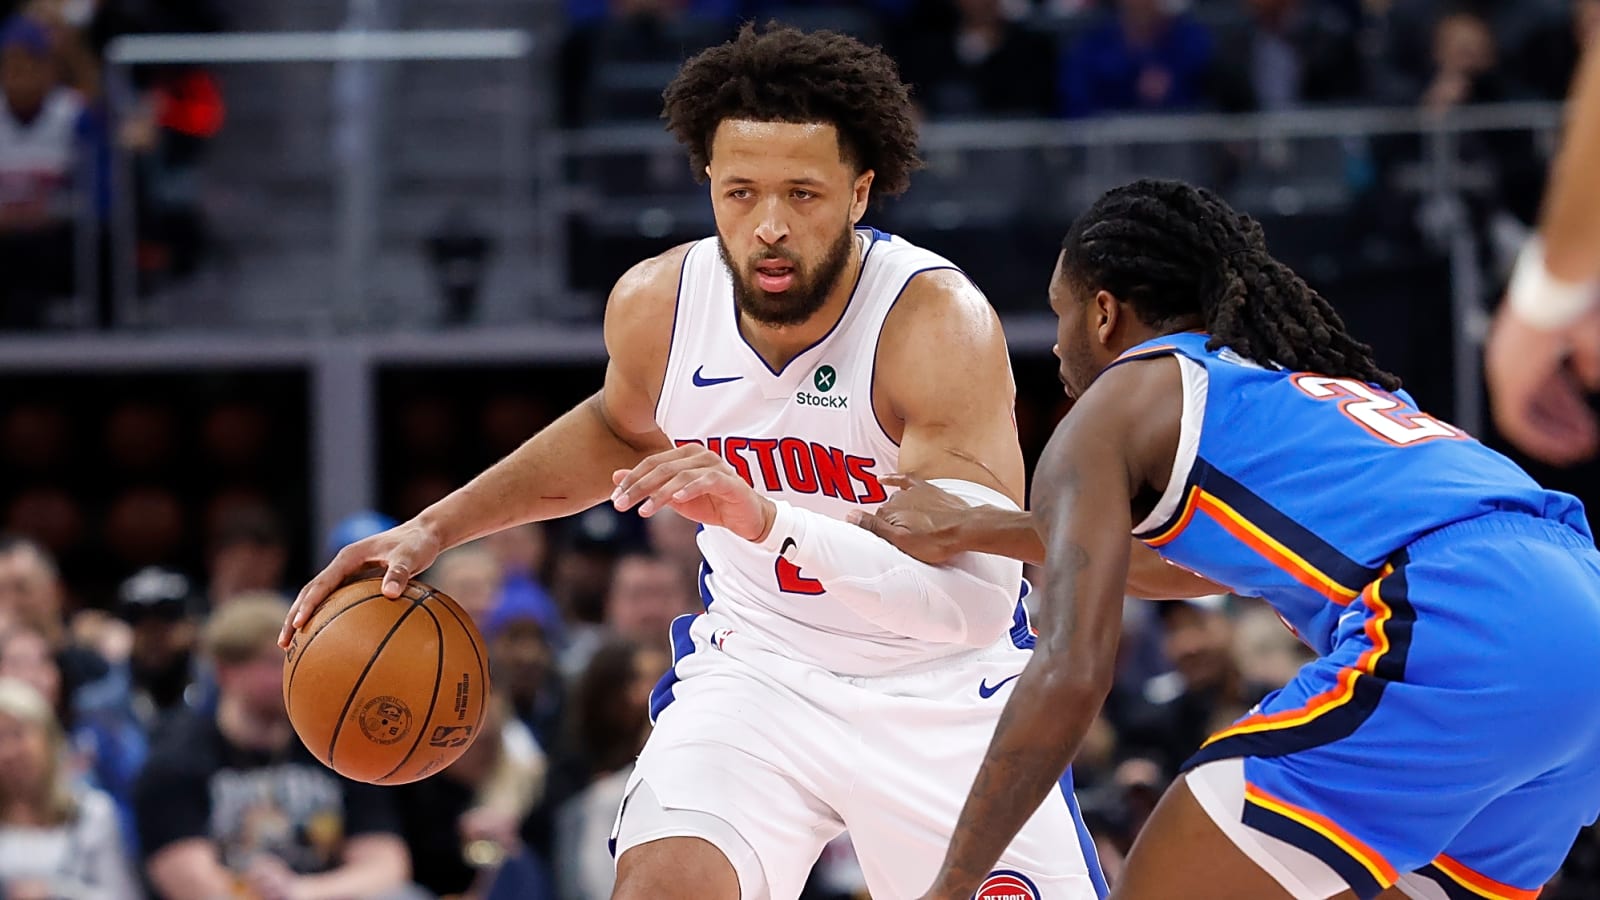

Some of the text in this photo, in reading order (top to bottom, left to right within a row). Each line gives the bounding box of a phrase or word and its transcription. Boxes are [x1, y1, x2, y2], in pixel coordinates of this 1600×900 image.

[796, 392, 848, 409] StockX
[1289, 371, 1468, 448] 2
[674, 436, 887, 504] STONS
